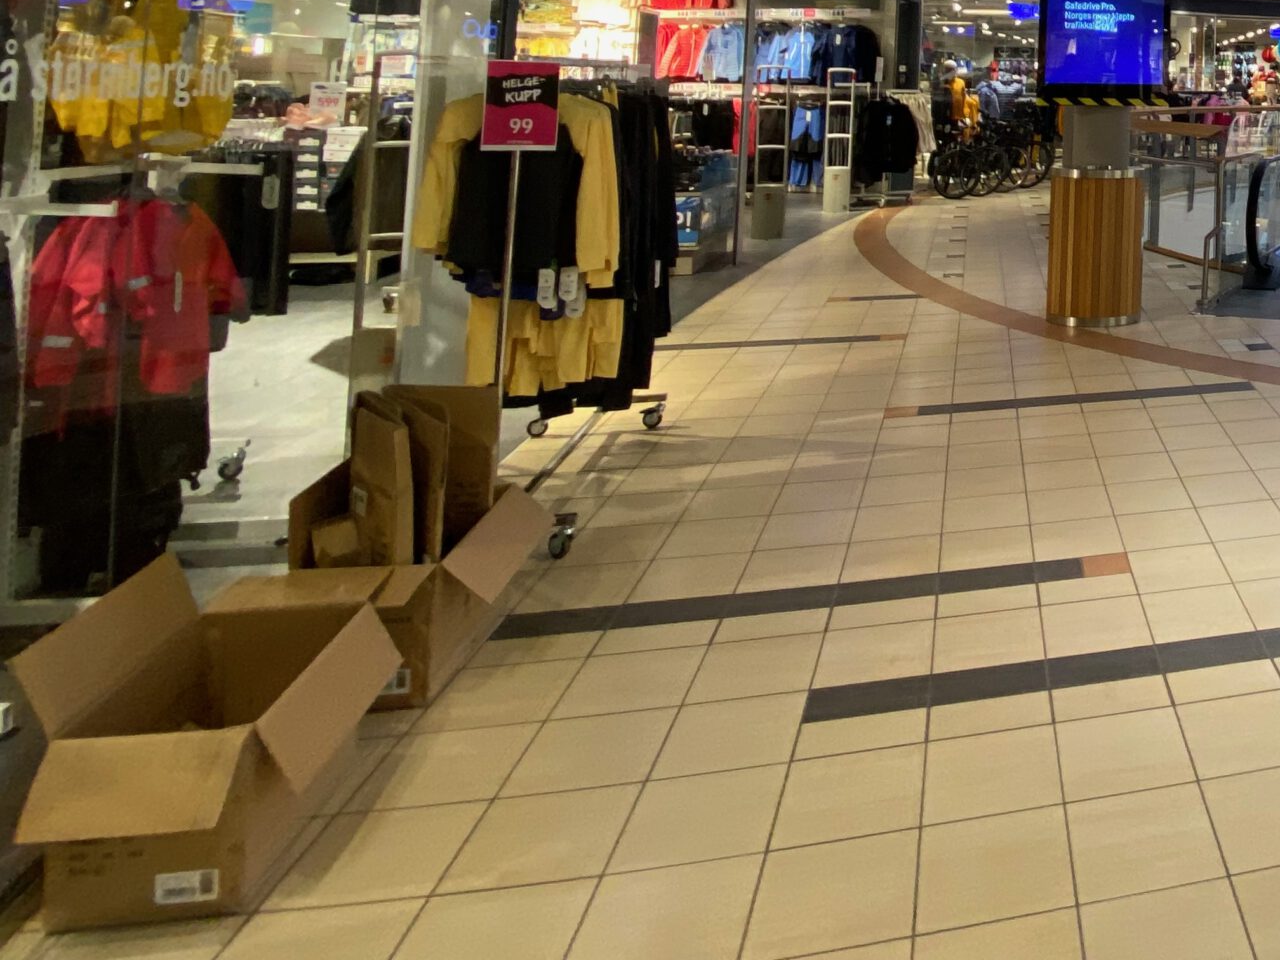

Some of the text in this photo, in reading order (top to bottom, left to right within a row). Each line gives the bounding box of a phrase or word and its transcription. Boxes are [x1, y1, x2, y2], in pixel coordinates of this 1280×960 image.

[502, 76, 547, 89] HELGE-
[505, 89, 542, 103] KUPP
[509, 118, 533, 134] 99
